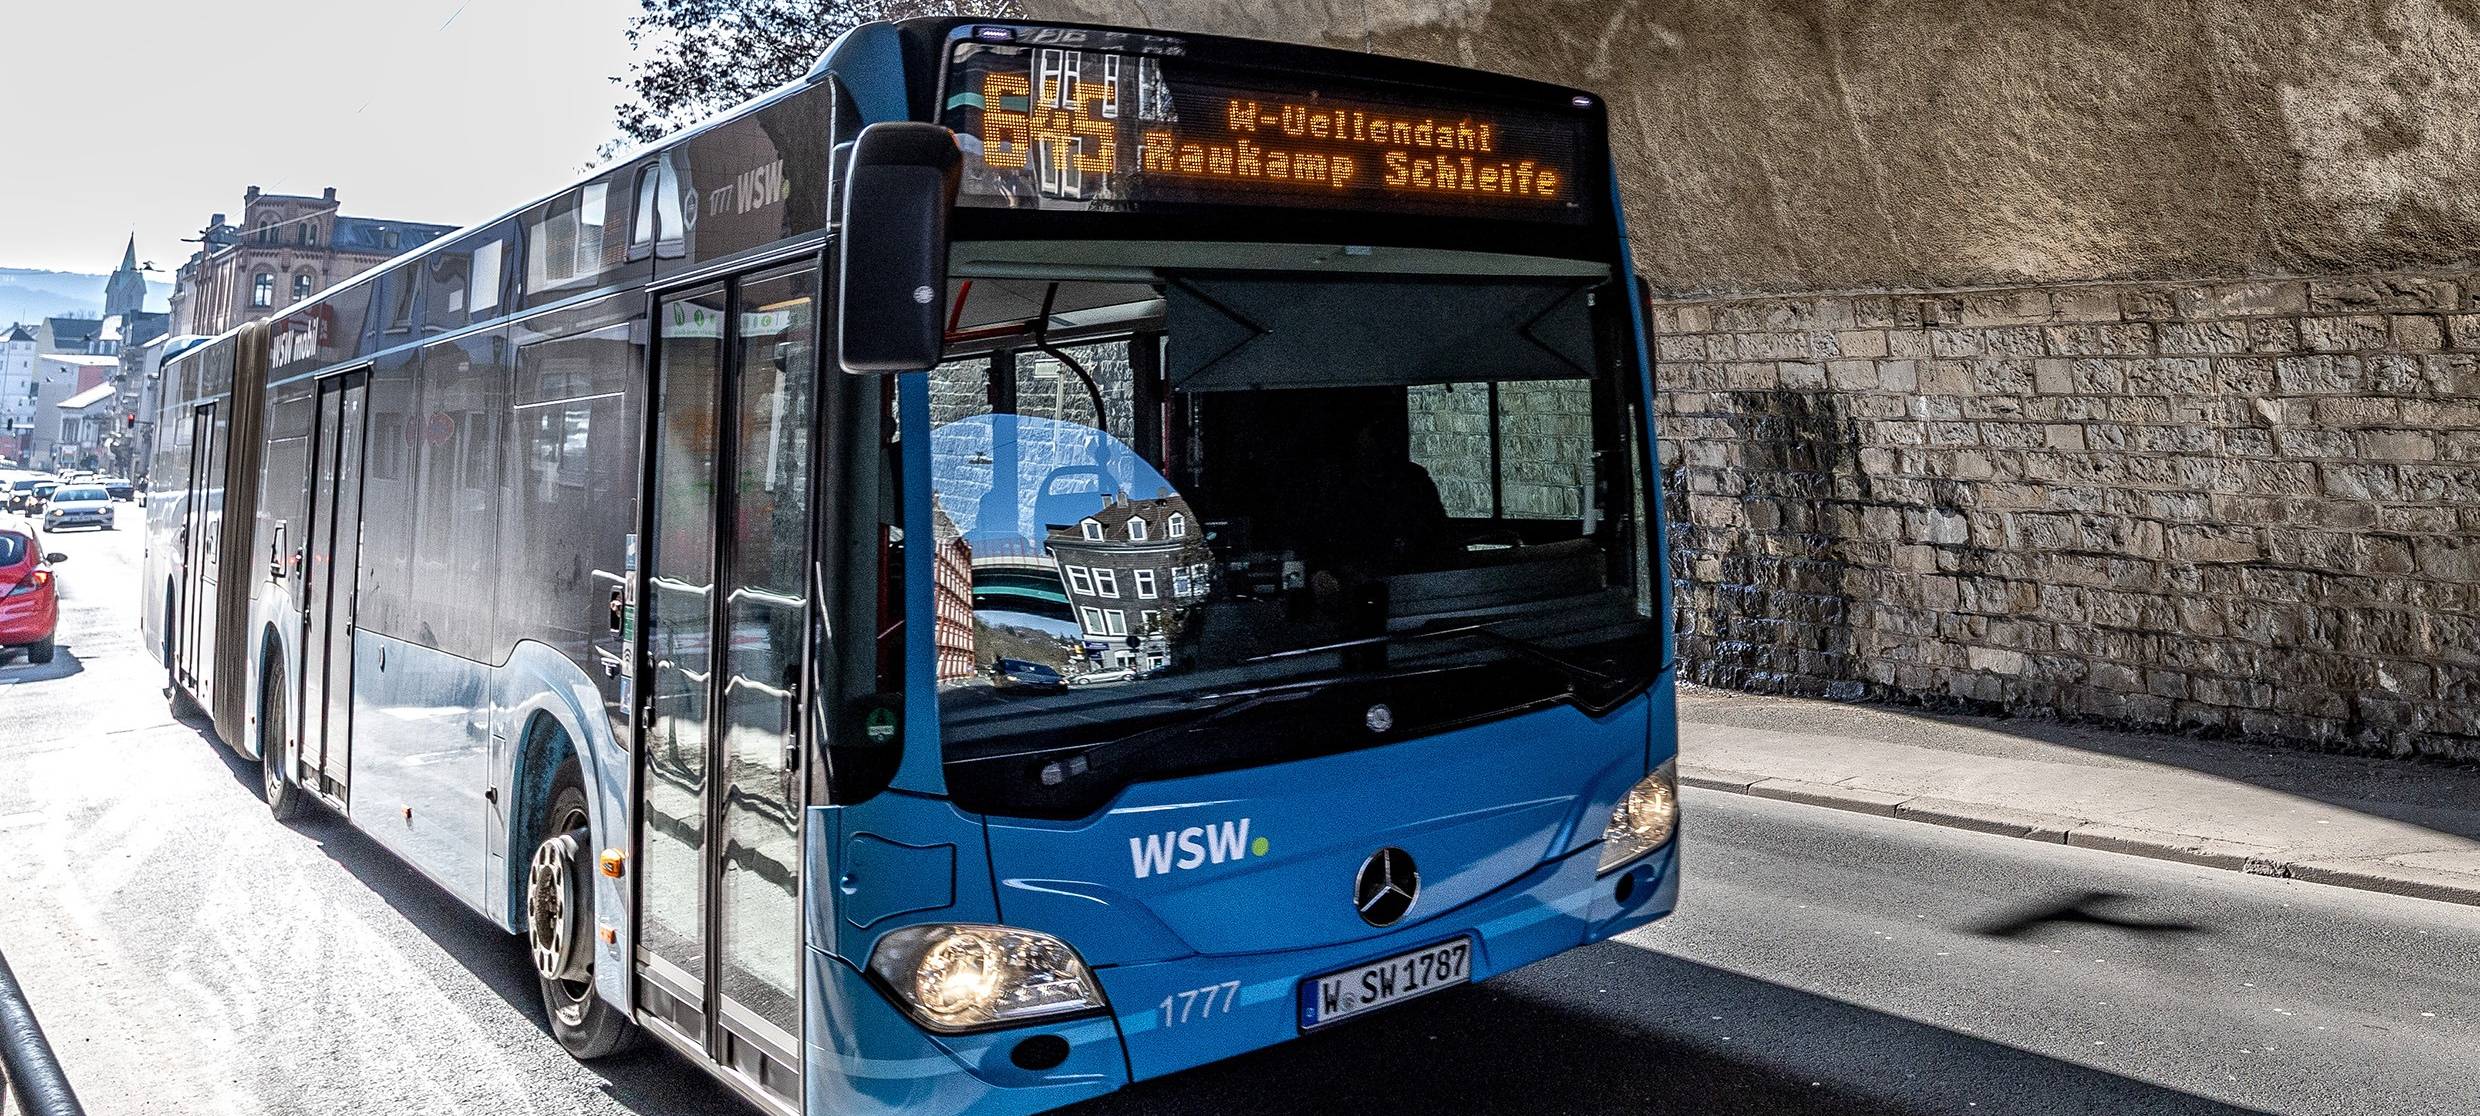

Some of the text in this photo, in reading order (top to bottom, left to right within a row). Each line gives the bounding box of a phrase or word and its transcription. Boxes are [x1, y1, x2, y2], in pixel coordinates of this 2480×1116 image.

[984, 74, 1115, 172] 645
[1145, 132, 1556, 195] Raukamp Schleife
[272, 317, 319, 368] WSW mobil
[1159, 980, 1242, 1028] 1777
